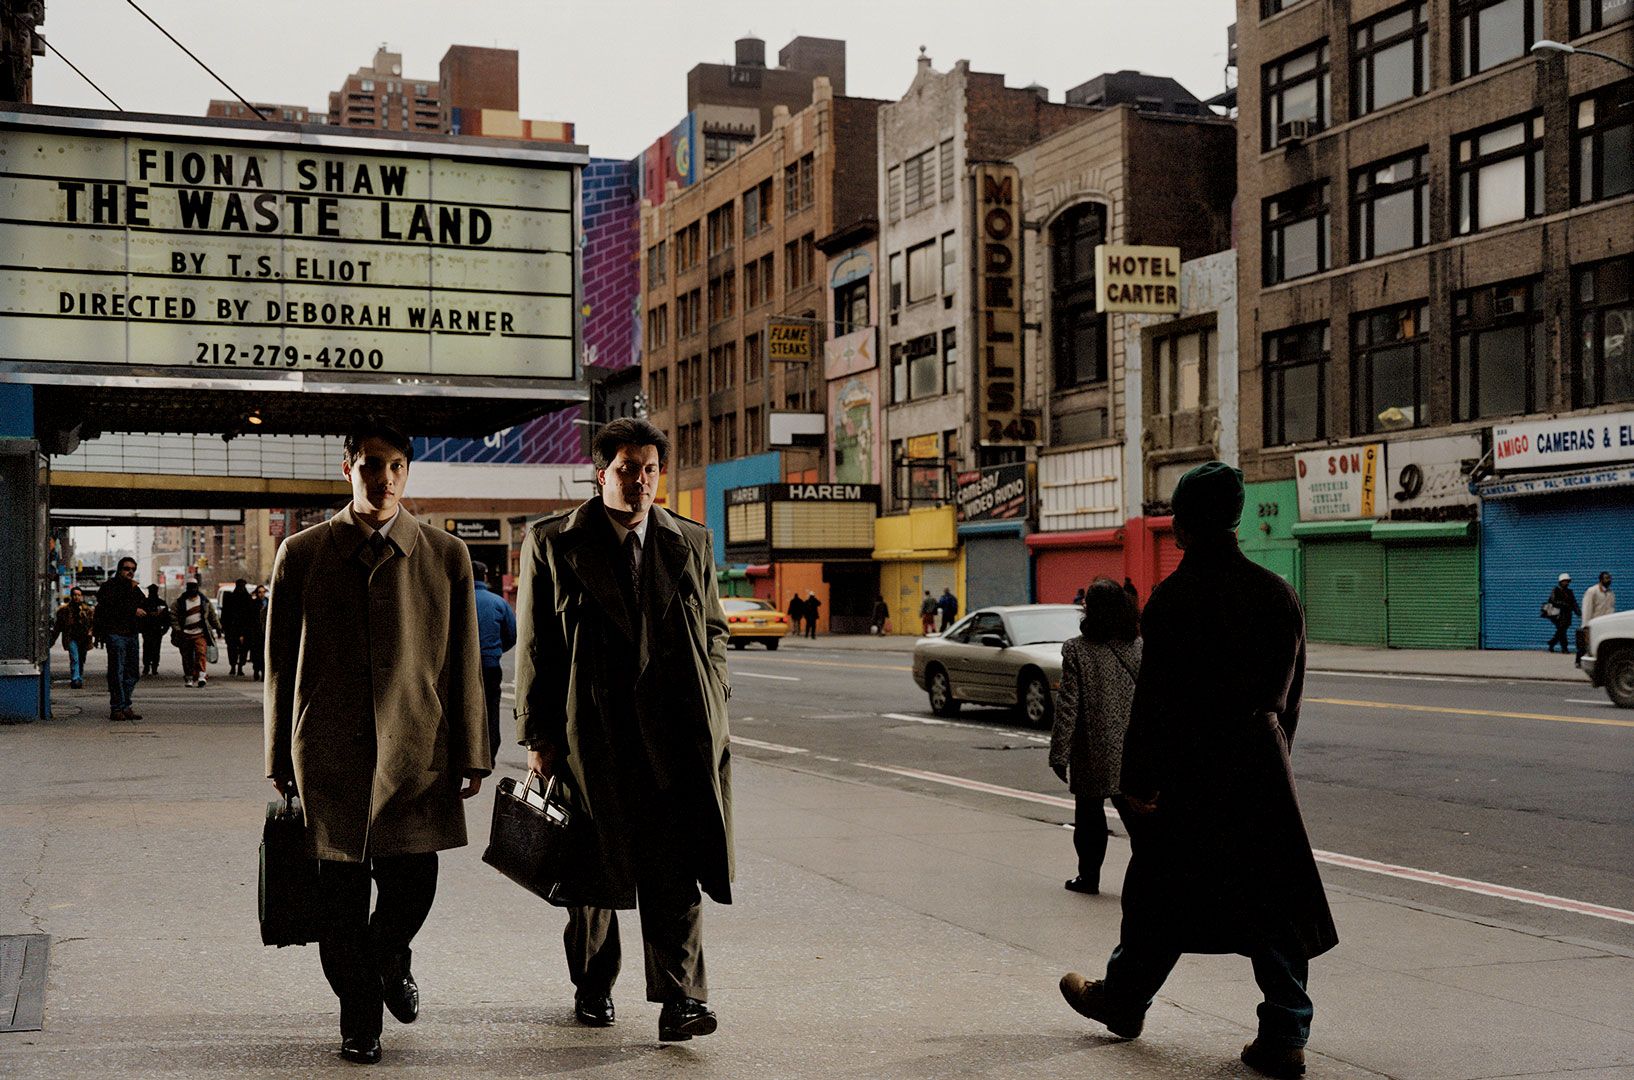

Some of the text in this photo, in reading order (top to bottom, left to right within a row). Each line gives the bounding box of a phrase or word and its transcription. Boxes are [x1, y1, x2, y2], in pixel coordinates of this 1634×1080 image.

[138, 149, 407, 196] FIONA SHAW
[58, 181, 492, 245] THE WASTE LAND
[171, 251, 372, 282] BY T.S. ELIOT
[1108, 256, 1176, 277] HOTEL
[1107, 283, 1177, 304] CARTER
[60, 291, 514, 332] DIRECTED BY DEBORAH WARNER
[771, 327, 807, 341] FLAME
[197, 342, 383, 370] 212-279-4200
[771, 342, 807, 355] STEAKS
[1497, 434, 1529, 460] AMIGO
[1537, 428, 1595, 454] CAMERAS
[1602, 427, 1611, 448] &
[789, 484, 861, 500] HAREM
